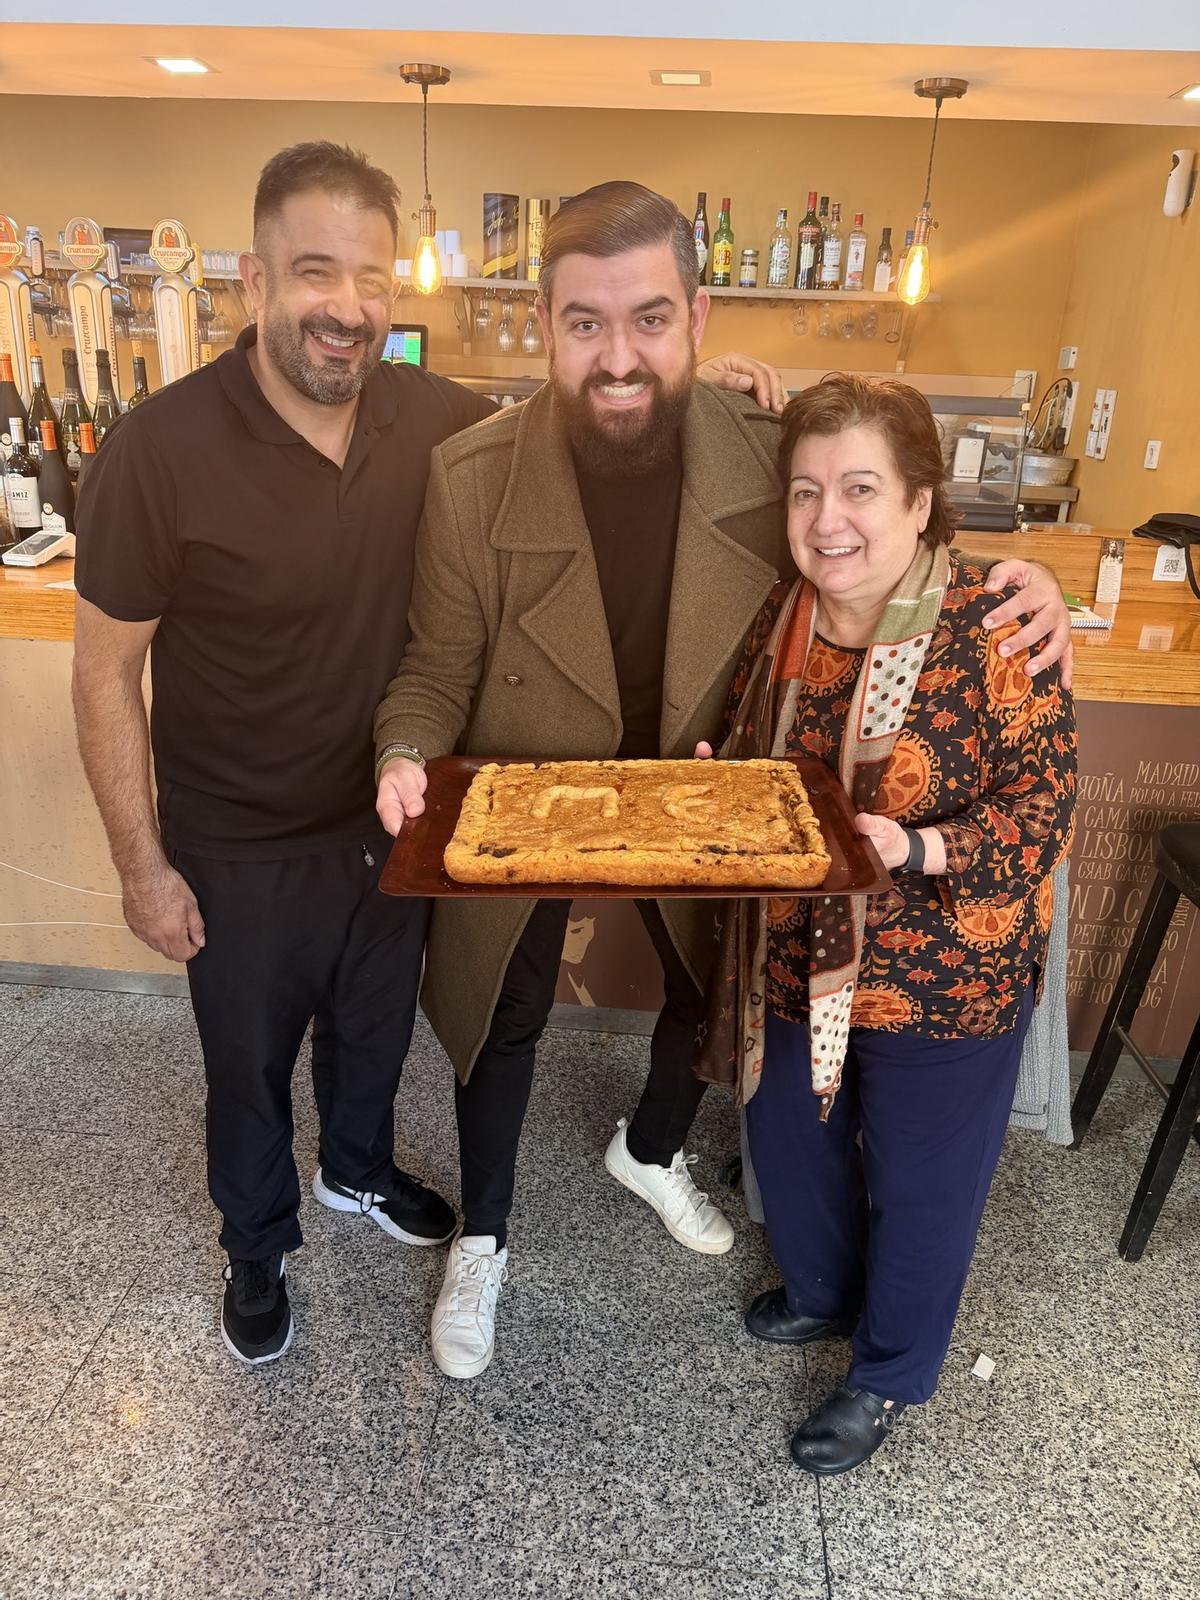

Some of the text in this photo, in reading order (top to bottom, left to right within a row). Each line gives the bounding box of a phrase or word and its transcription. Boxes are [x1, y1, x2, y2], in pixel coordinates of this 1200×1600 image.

[66, 246, 100, 255] Cruzcampo
[153, 248, 188, 258] Cruzcampo
[80, 305, 91, 354] Cruzcampo
[1135, 760, 1200, 787] MADRID
[1076, 772, 1124, 802] RUÑA
[1129, 787, 1200, 808] PULPO A FEI
[1080, 830, 1155, 863] LISBOA
[1077, 861, 1151, 883] CRAB CAKE
[1068, 884, 1092, 920] N
[1089, 982, 1117, 1005] HO
